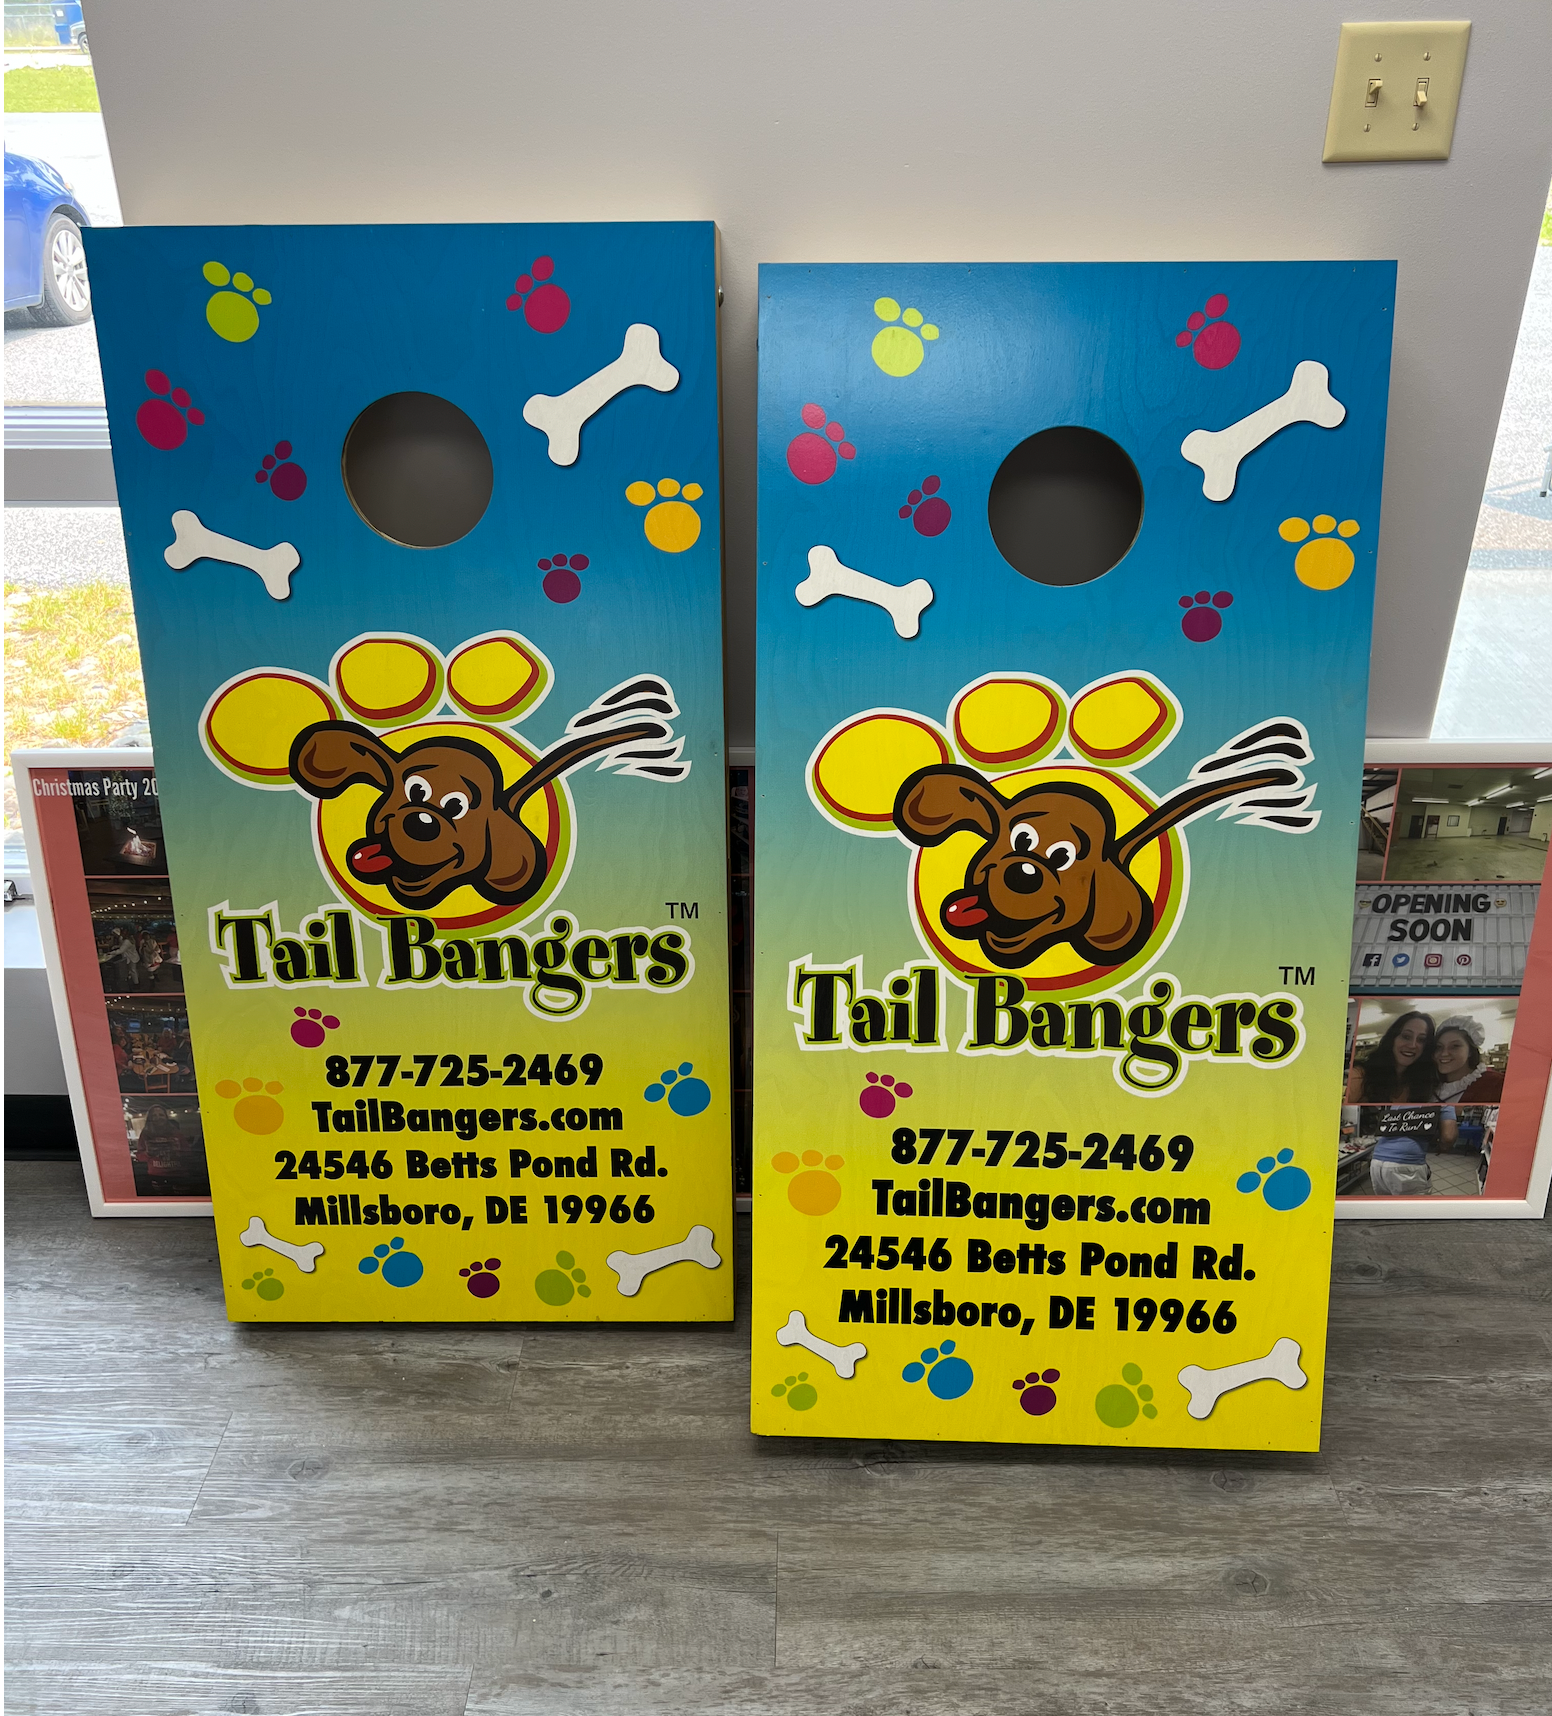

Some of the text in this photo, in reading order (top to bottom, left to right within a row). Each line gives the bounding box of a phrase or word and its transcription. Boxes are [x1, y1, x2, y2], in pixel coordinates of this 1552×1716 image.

[33, 778, 100, 796] Christmas
[103, 778, 138, 800] Party
[665, 902, 699, 919] TM
[1372, 893, 1491, 914] OPENING
[1387, 918, 1472, 942] SOON
[216, 910, 689, 1014] Tail Bangers
[1278, 966, 1315, 986] TM
[795, 967, 1300, 1090] Tail Bangers
[325, 1053, 604, 1088] 877-725-2469
[311, 1098, 623, 1141] TailBangers.com
[1381, 1110, 1436, 1122] Last Chance
[1388, 1120, 1423, 1132] To Run!
[274, 1145, 668, 1180] 24546 Betts Pond Rd.
[891, 1127, 1194, 1172] 877-725-2469
[295, 1194, 655, 1231] Millsboro, DE 19966
[871, 1177, 1211, 1231] TailBangers.com
[823, 1234, 1256, 1281] 24546 Betts Pond Rd.
[838, 1287, 1237, 1336] Millsboro, DE 19966
